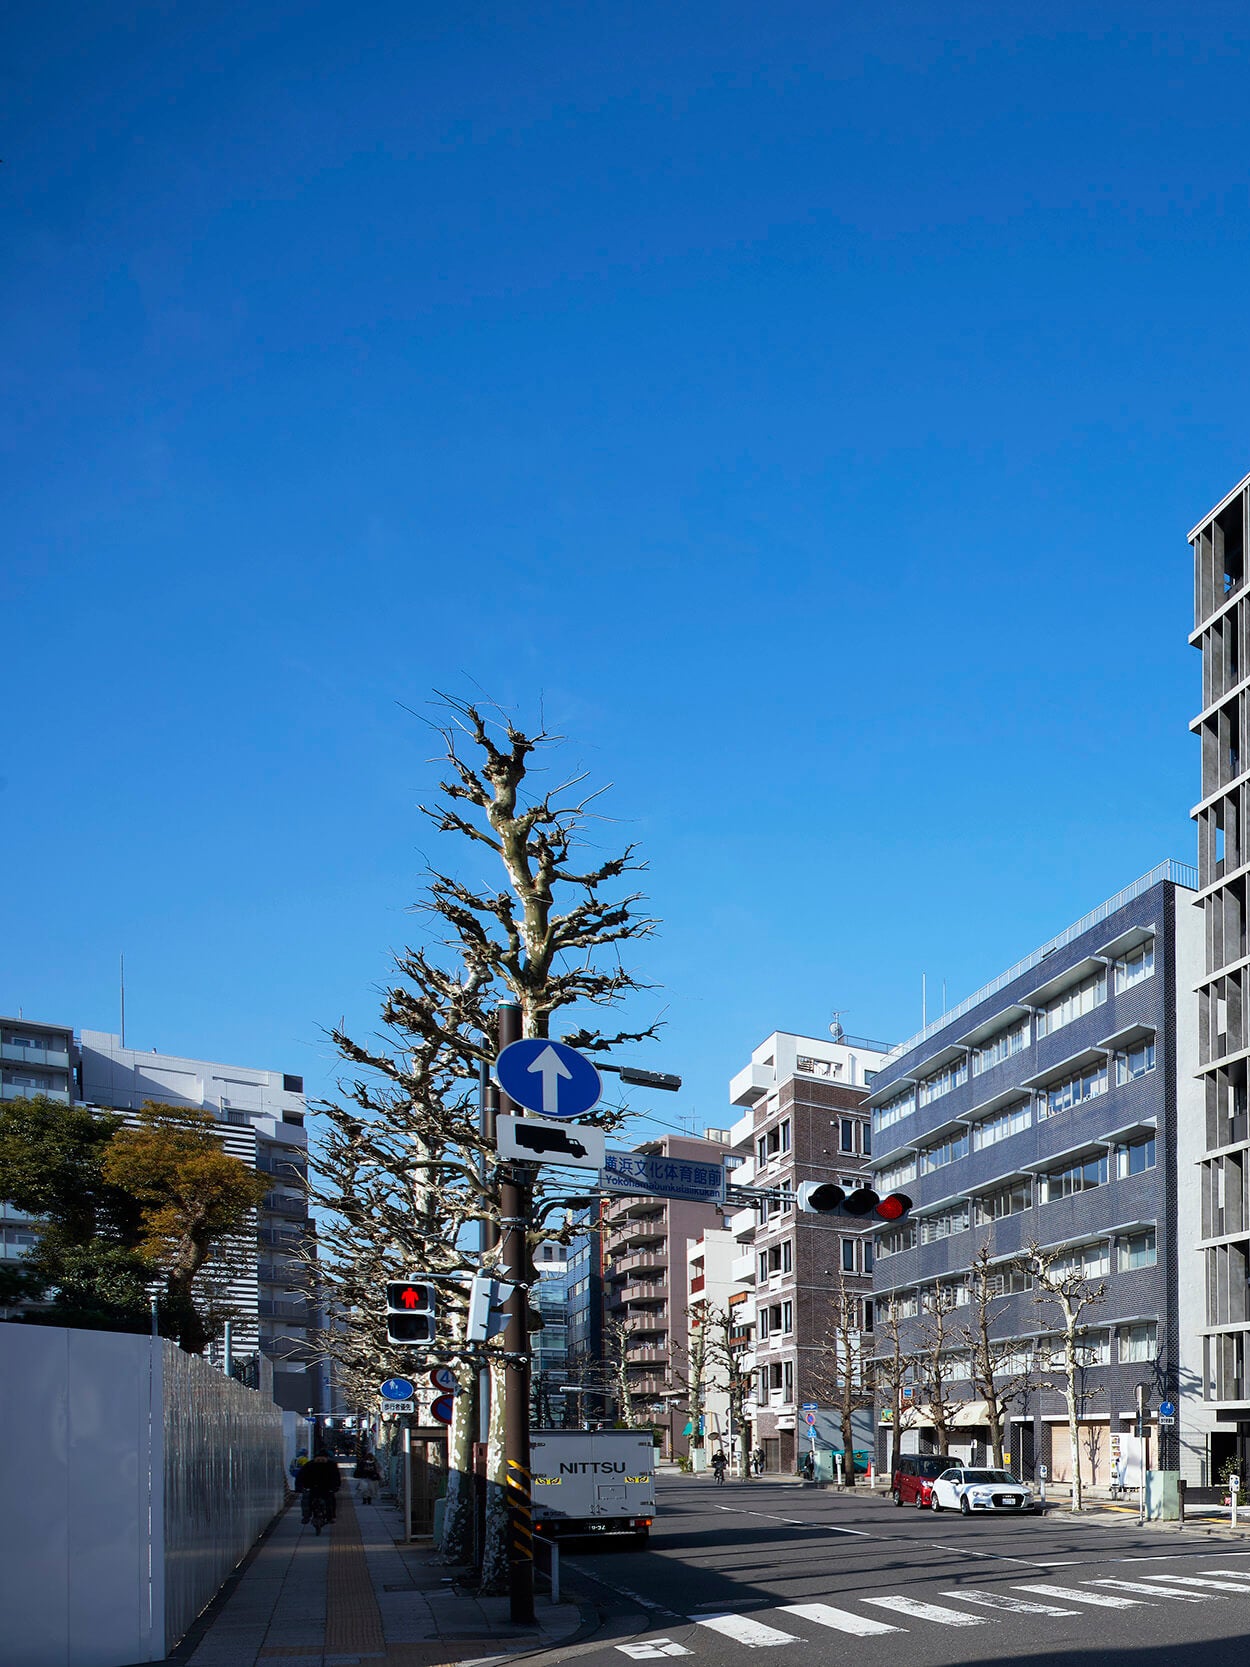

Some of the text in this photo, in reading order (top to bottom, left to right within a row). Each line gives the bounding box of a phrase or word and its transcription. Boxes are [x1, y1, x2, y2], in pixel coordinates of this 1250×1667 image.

[604, 1154, 721, 1187] 横浜文化体育館前
[560, 1462, 626, 1474] NITTSU
